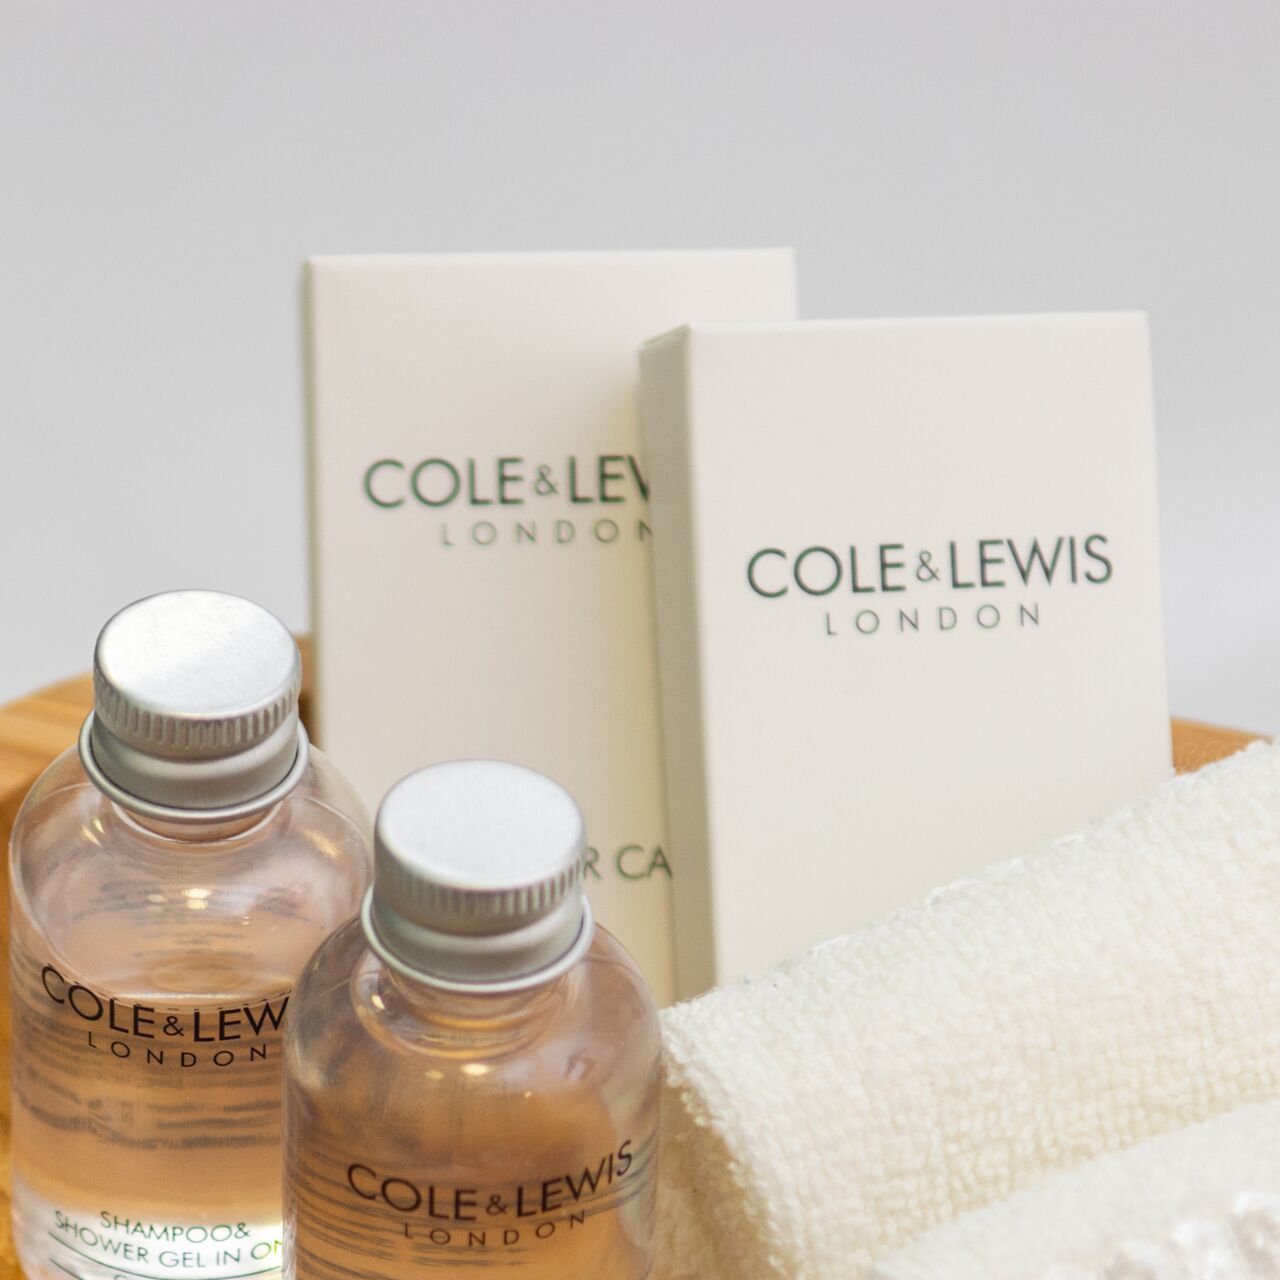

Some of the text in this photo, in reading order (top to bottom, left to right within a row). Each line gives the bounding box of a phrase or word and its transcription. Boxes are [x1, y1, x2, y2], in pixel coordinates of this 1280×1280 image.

[362, 454, 650, 509] COLE&LE
[746, 533, 1113, 599] COLE&LEWIS
[824, 602, 1040, 636] LONDON
[615, 844, 673, 881] CA
[41, 965, 291, 1043] COLE&LEW
[87, 1030, 267, 1068] LONDON
[346, 1139, 633, 1221] COLE&LEWIS
[53, 1210, 150, 1264] SHOWER
[158, 1251, 207, 1269] GEL
[215, 1248, 241, 1266] IN
[99, 1210, 250, 1244] SHAMPOO&
[403, 1209, 586, 1247] LONDON
